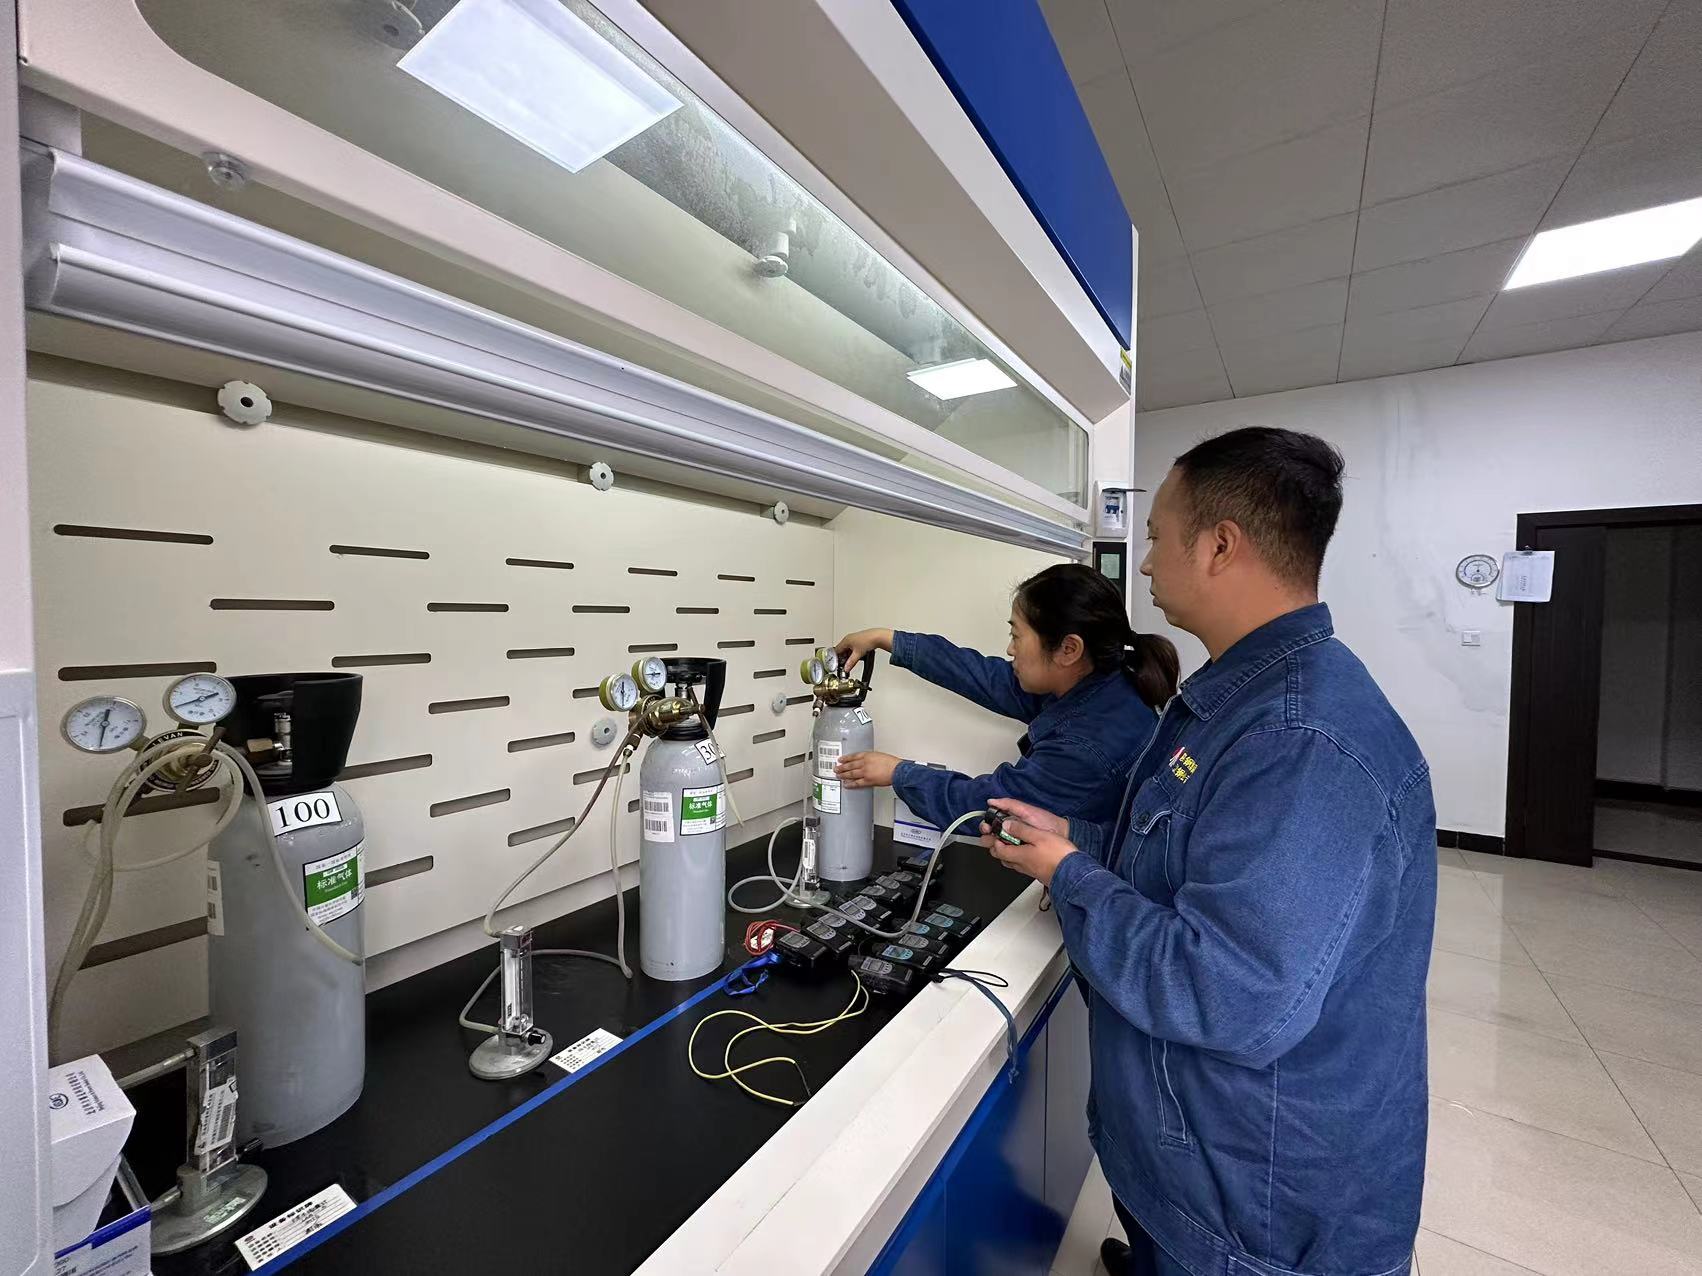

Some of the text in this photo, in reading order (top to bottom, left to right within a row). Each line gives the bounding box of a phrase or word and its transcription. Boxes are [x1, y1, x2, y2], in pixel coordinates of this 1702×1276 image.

[275, 798, 330, 828] 100
[688, 801, 713, 811] 标准气体
[316, 869, 352, 889] 标准气体
